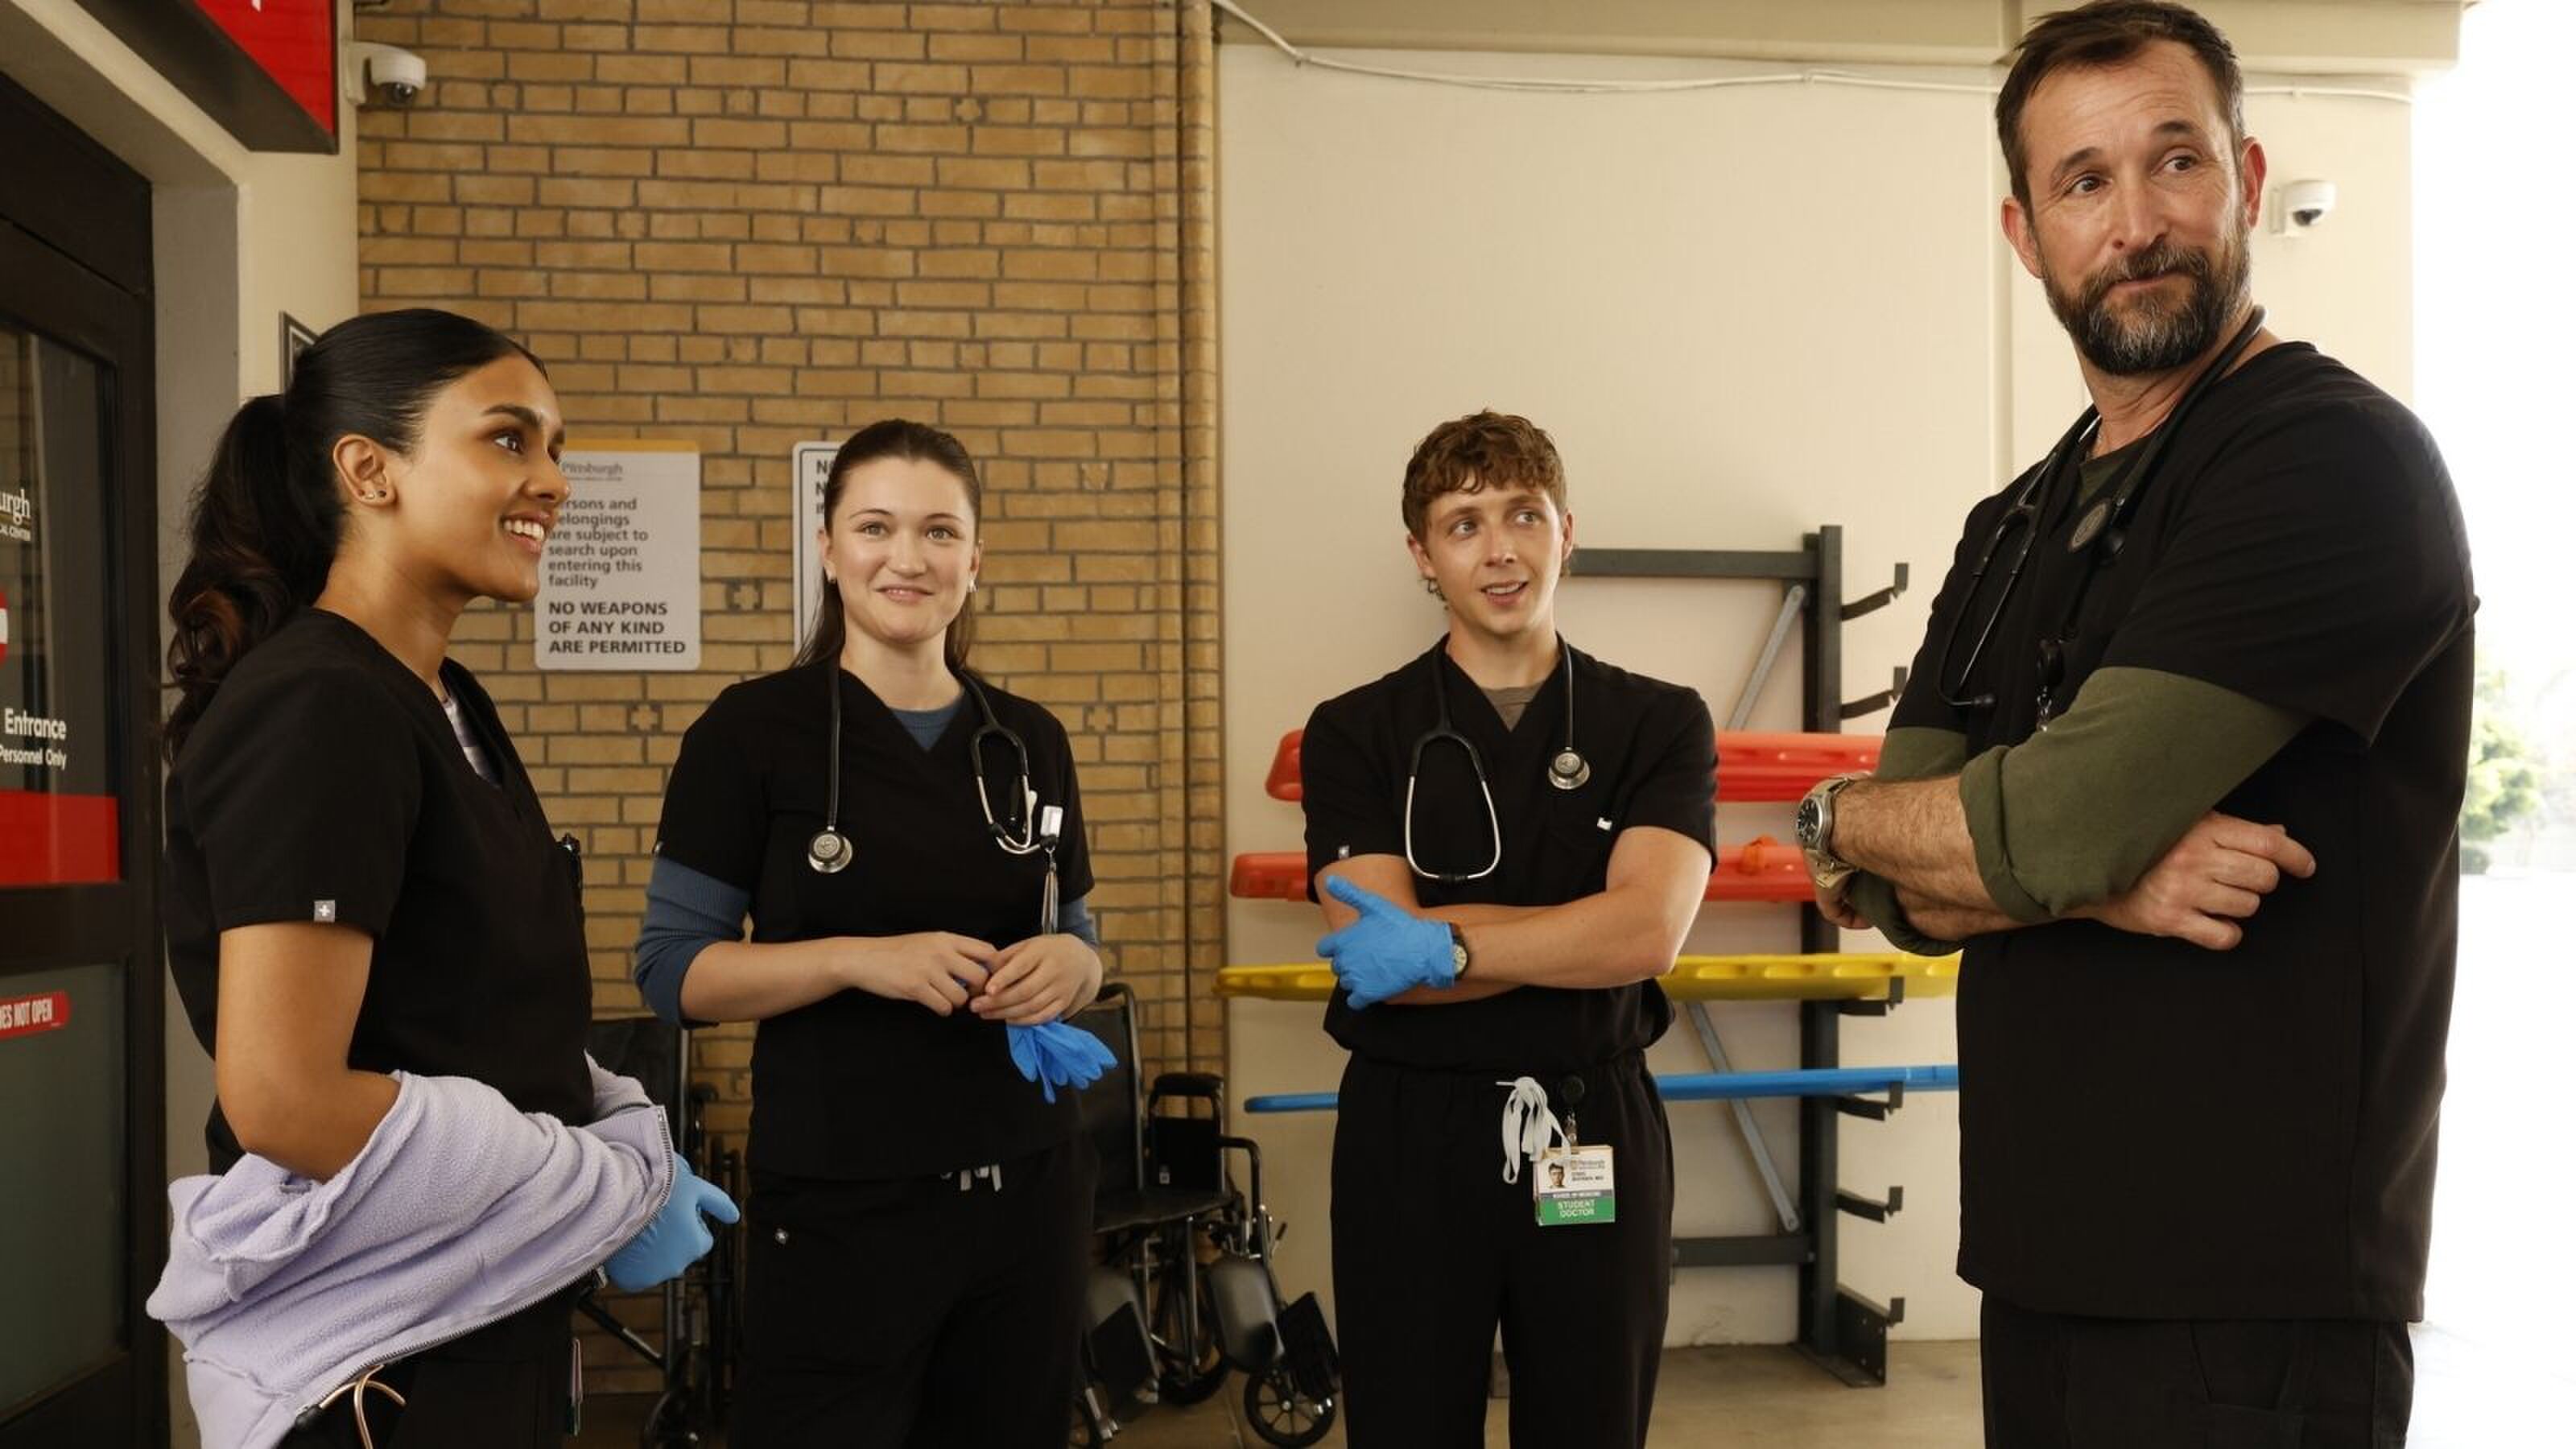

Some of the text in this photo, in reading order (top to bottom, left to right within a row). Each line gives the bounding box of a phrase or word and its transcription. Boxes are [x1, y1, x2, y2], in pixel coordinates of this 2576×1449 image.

[565, 497, 637, 510] rsons and
[558, 514, 630, 528] elongings
[550, 527, 649, 543] are subject to
[548, 543, 638, 559] search upon
[548, 559, 642, 574] entering this
[549, 574, 598, 589] facility
[548, 601, 668, 615] NO WEAPONS
[548, 621, 665, 634] OF ANY KIND
[548, 640, 686, 654] ARE PERMITTED
[5, 708, 67, 741] Entrance
[45, 748, 67, 770] Only
[14, 1001, 31, 1028] NOT
[31, 997, 52, 1025] OPEN
[1558, 1199, 1596, 1210] STUDENT
[1559, 1209, 1596, 1218] DOCTOR
